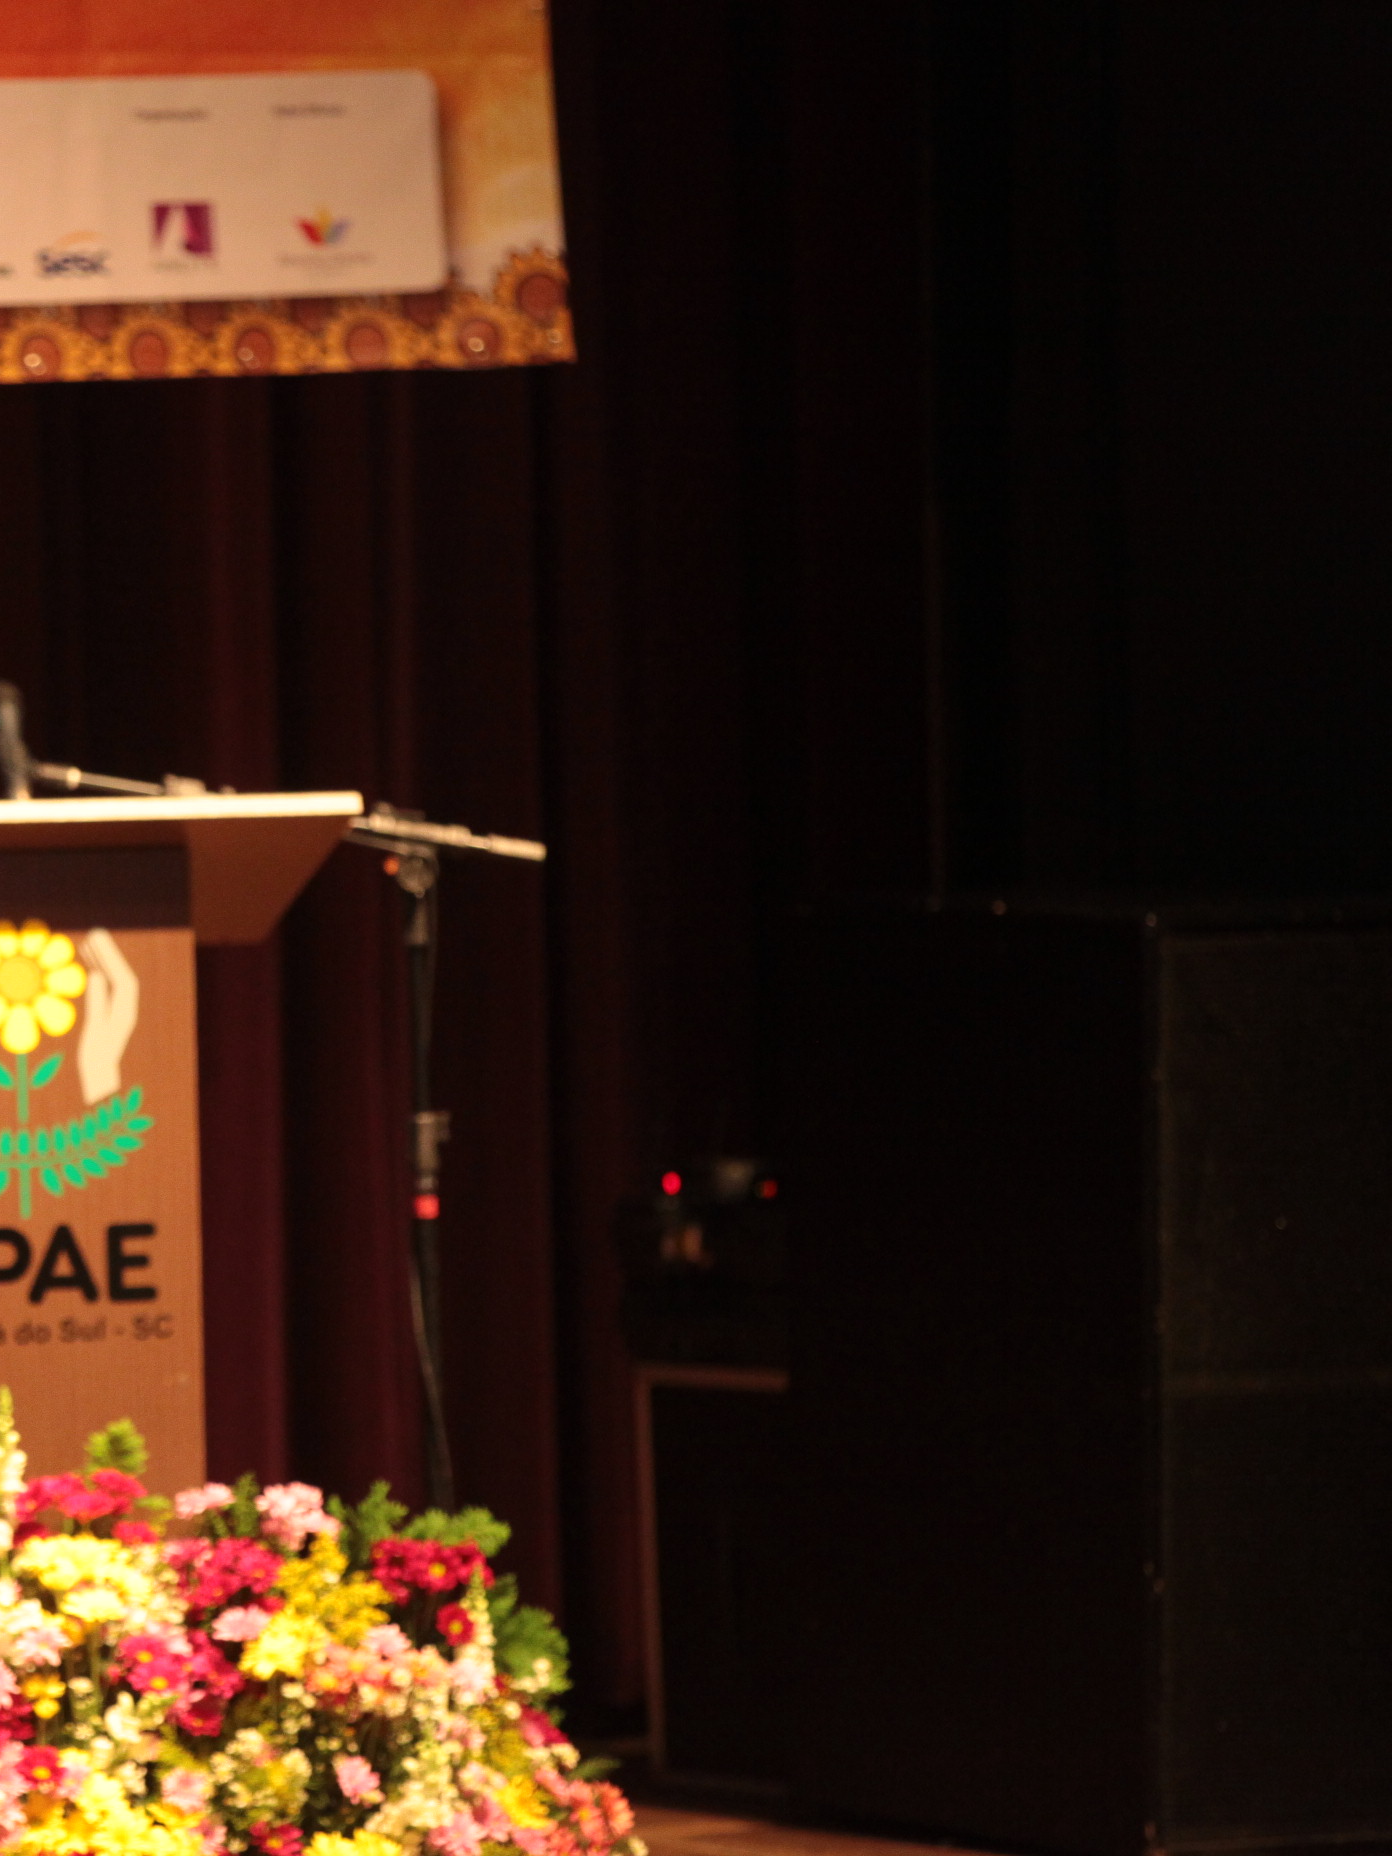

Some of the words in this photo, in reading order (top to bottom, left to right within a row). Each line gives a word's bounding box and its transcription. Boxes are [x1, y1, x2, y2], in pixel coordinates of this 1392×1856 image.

[13, 1319, 52, 1346] do
[60, 1316, 106, 1343] Sul
[133, 1313, 174, 1341] SC
